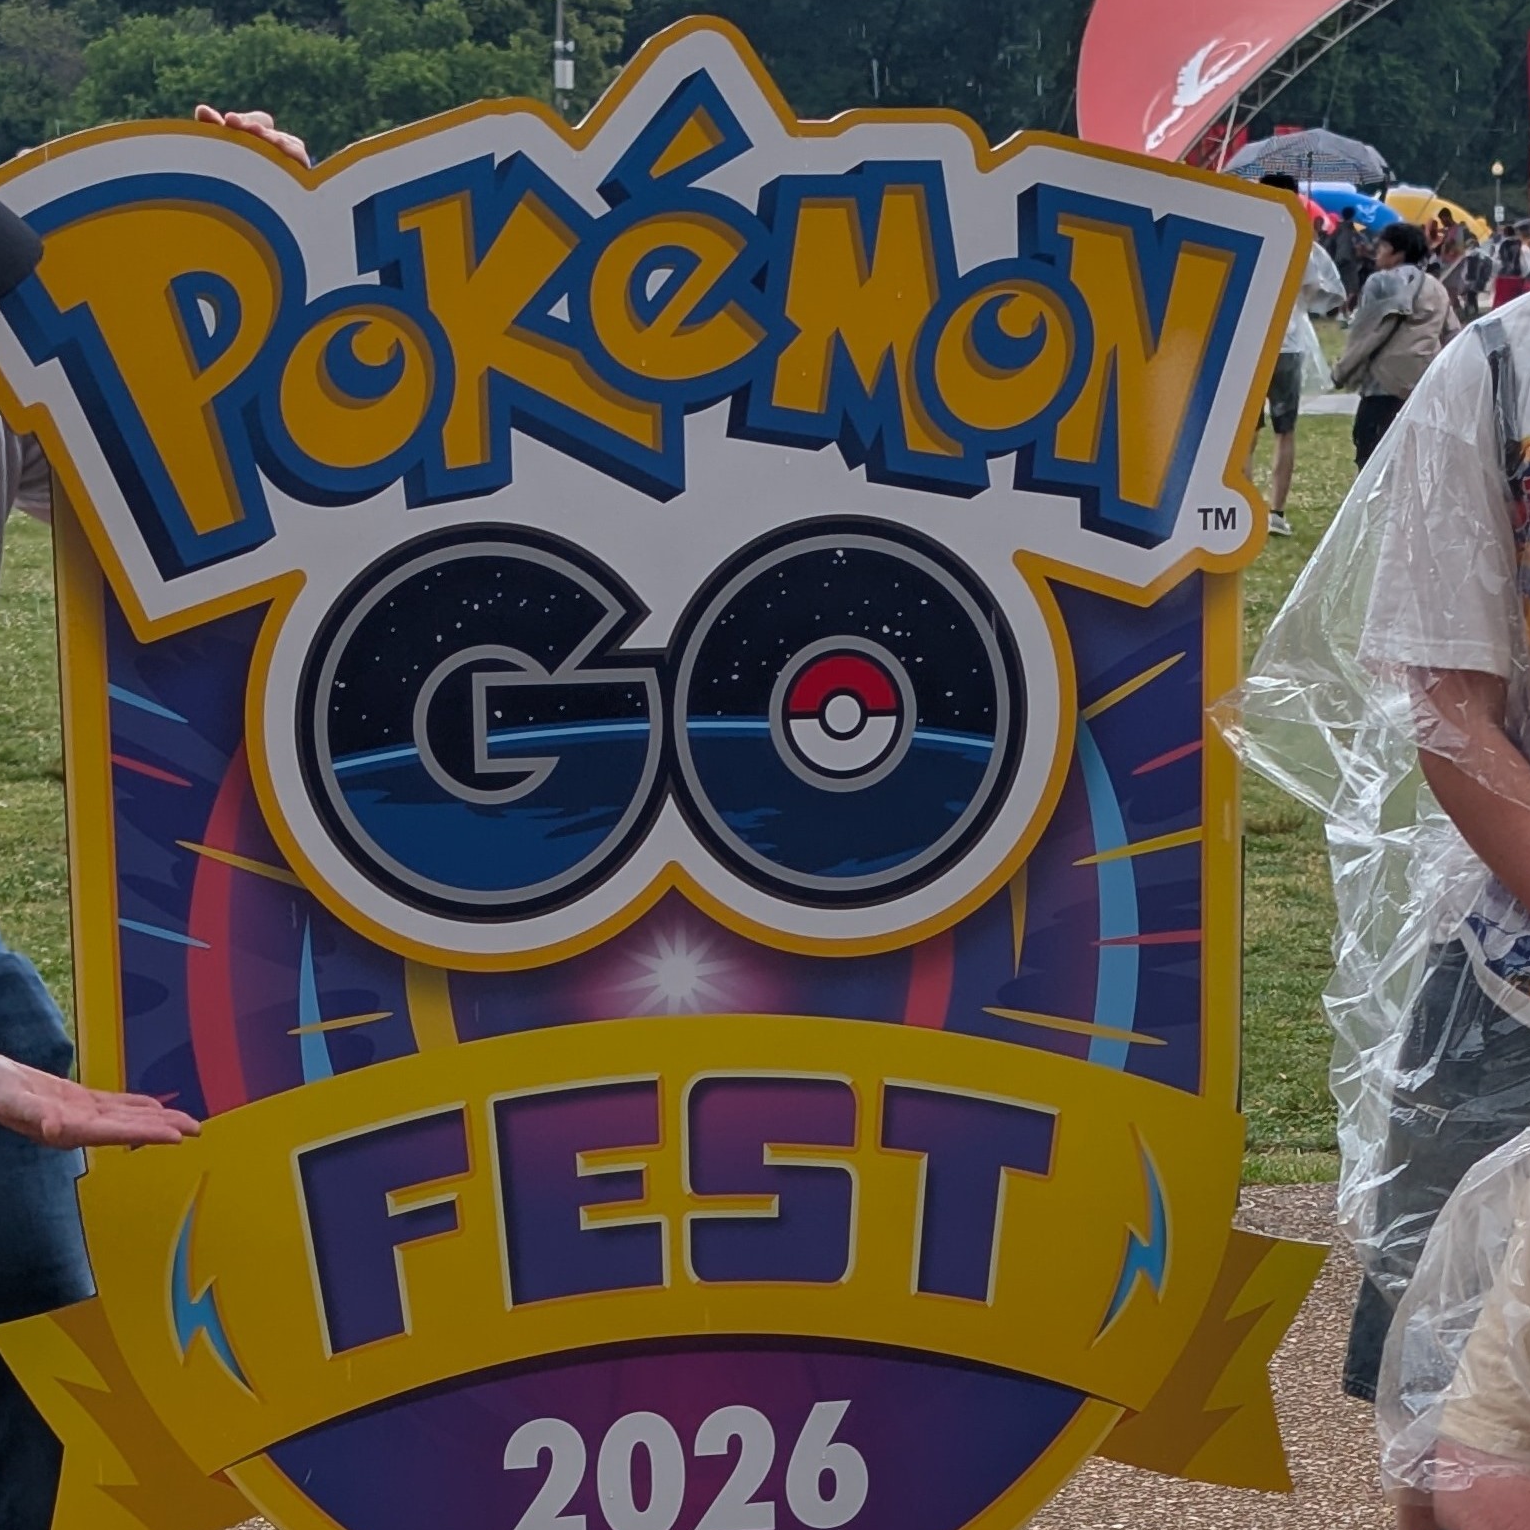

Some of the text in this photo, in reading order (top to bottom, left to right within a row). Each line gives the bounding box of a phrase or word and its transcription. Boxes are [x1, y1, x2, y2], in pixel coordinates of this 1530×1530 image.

[1197, 506, 1237, 531] TM
[297, 514, 1028, 924] GO
[291, 1070, 1061, 1359] FEST
